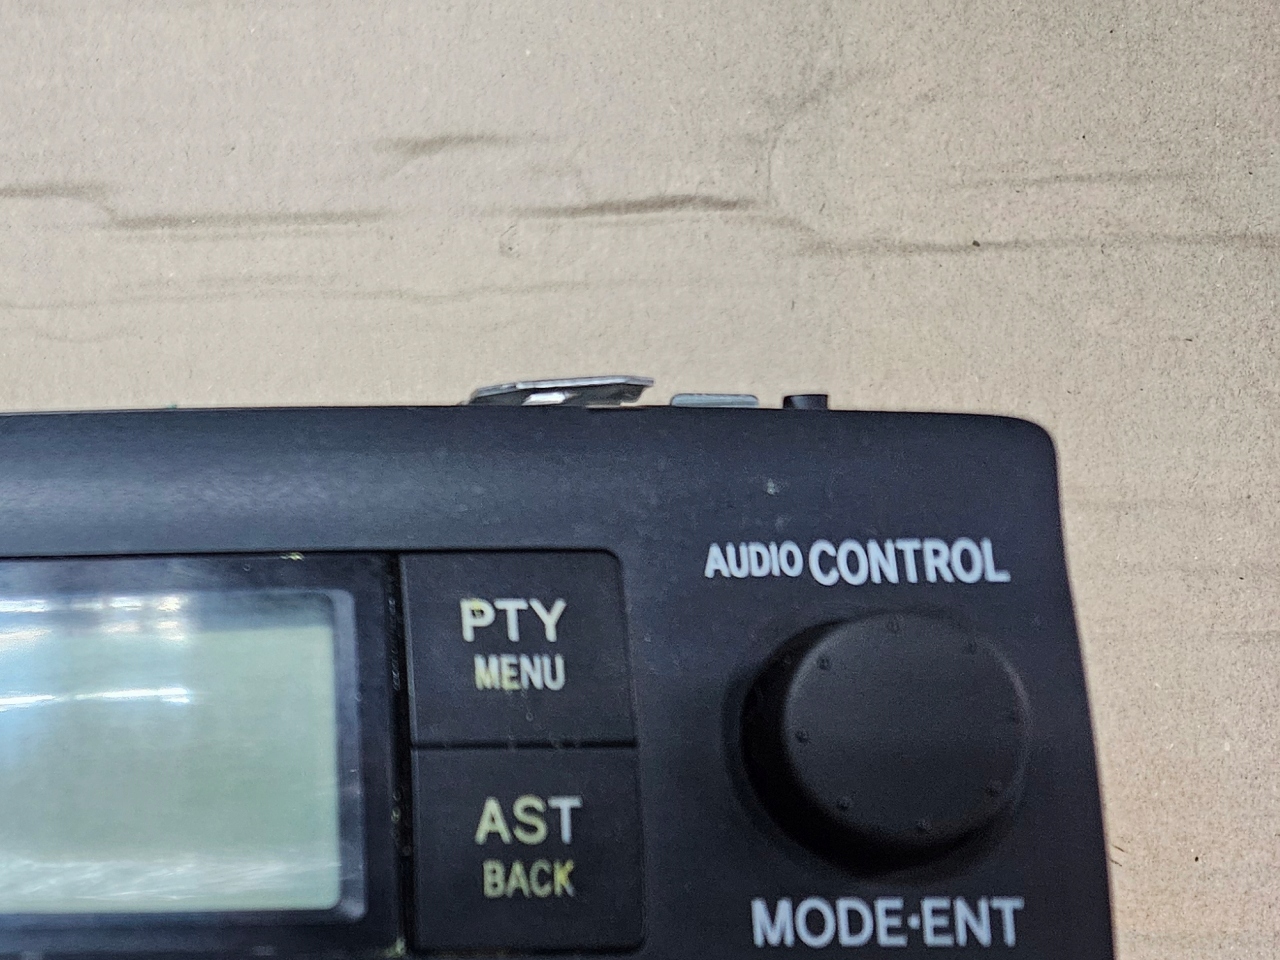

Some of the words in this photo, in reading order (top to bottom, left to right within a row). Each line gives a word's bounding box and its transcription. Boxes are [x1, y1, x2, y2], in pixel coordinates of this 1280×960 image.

[704, 541, 804, 579] AUDIO
[808, 536, 1011, 586] CONTROL
[460, 597, 567, 643] PTY
[473, 653, 566, 692] MENU
[475, 795, 583, 845] AST
[482, 859, 574, 899] BACK
